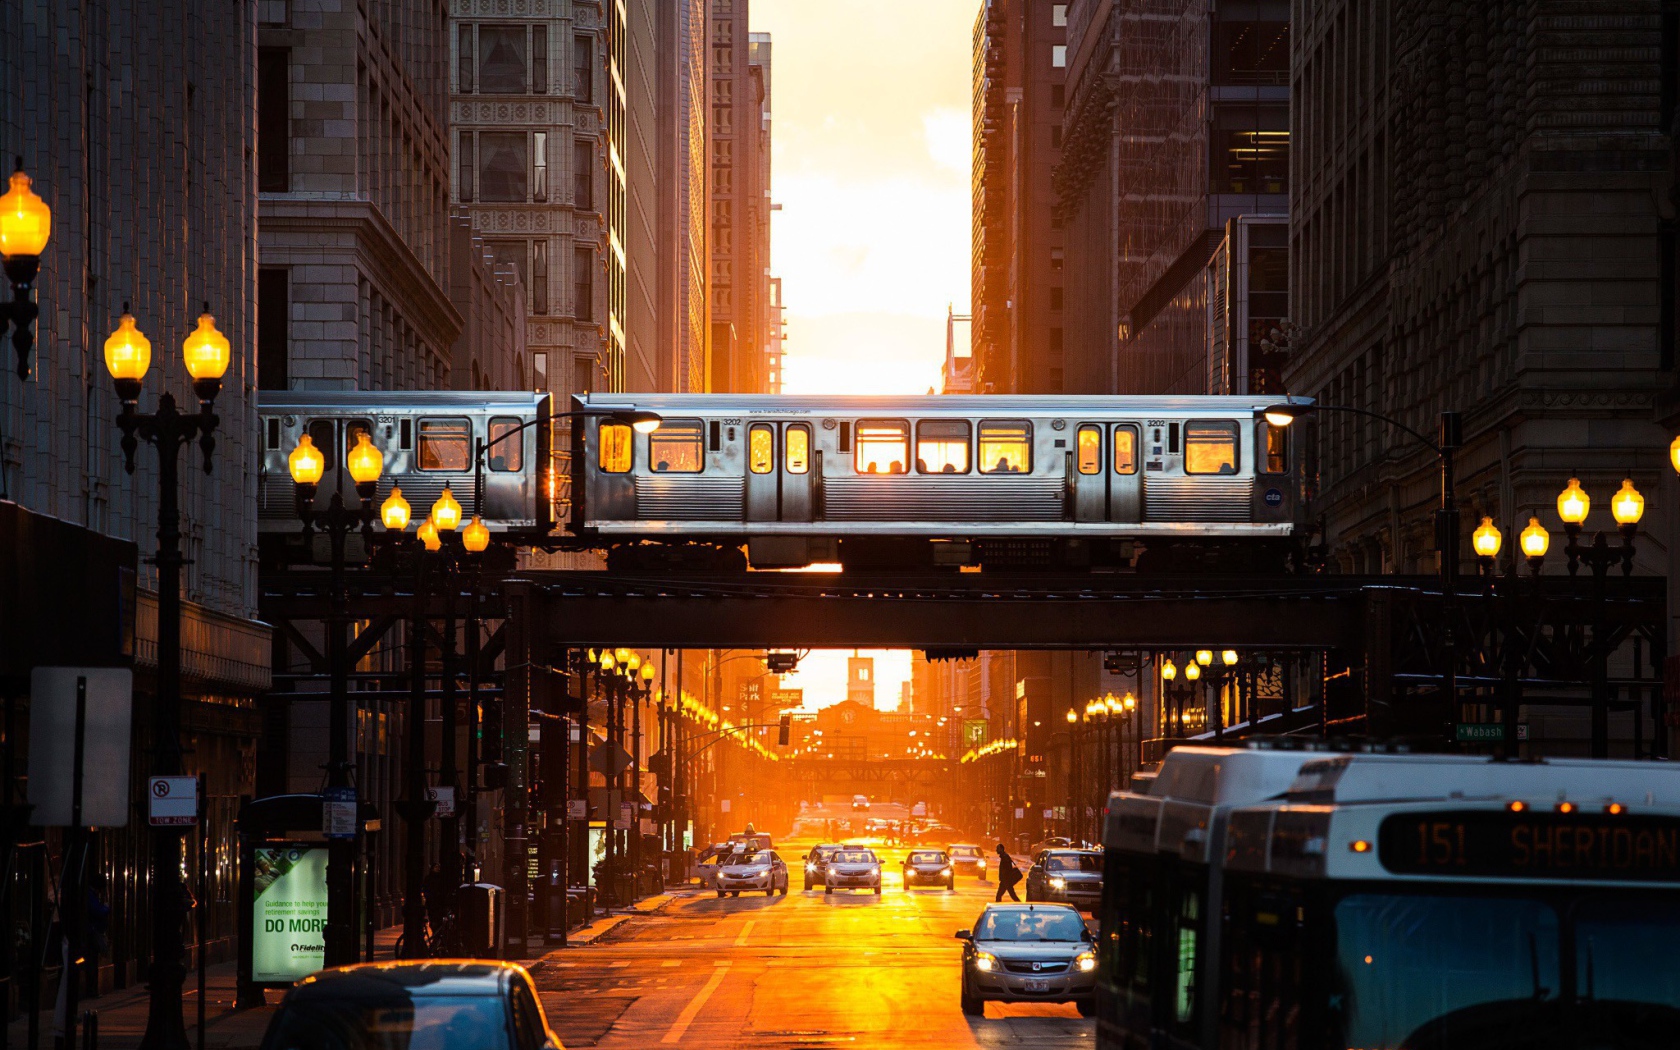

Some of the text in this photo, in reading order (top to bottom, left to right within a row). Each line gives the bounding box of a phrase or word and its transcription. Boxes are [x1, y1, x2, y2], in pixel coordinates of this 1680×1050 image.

[723, 418, 741, 426] 3202
[1466, 727, 1502, 737] Wabash
[1417, 821, 1680, 868] 151 SHERIDAN
[265, 918, 285, 933] DO
